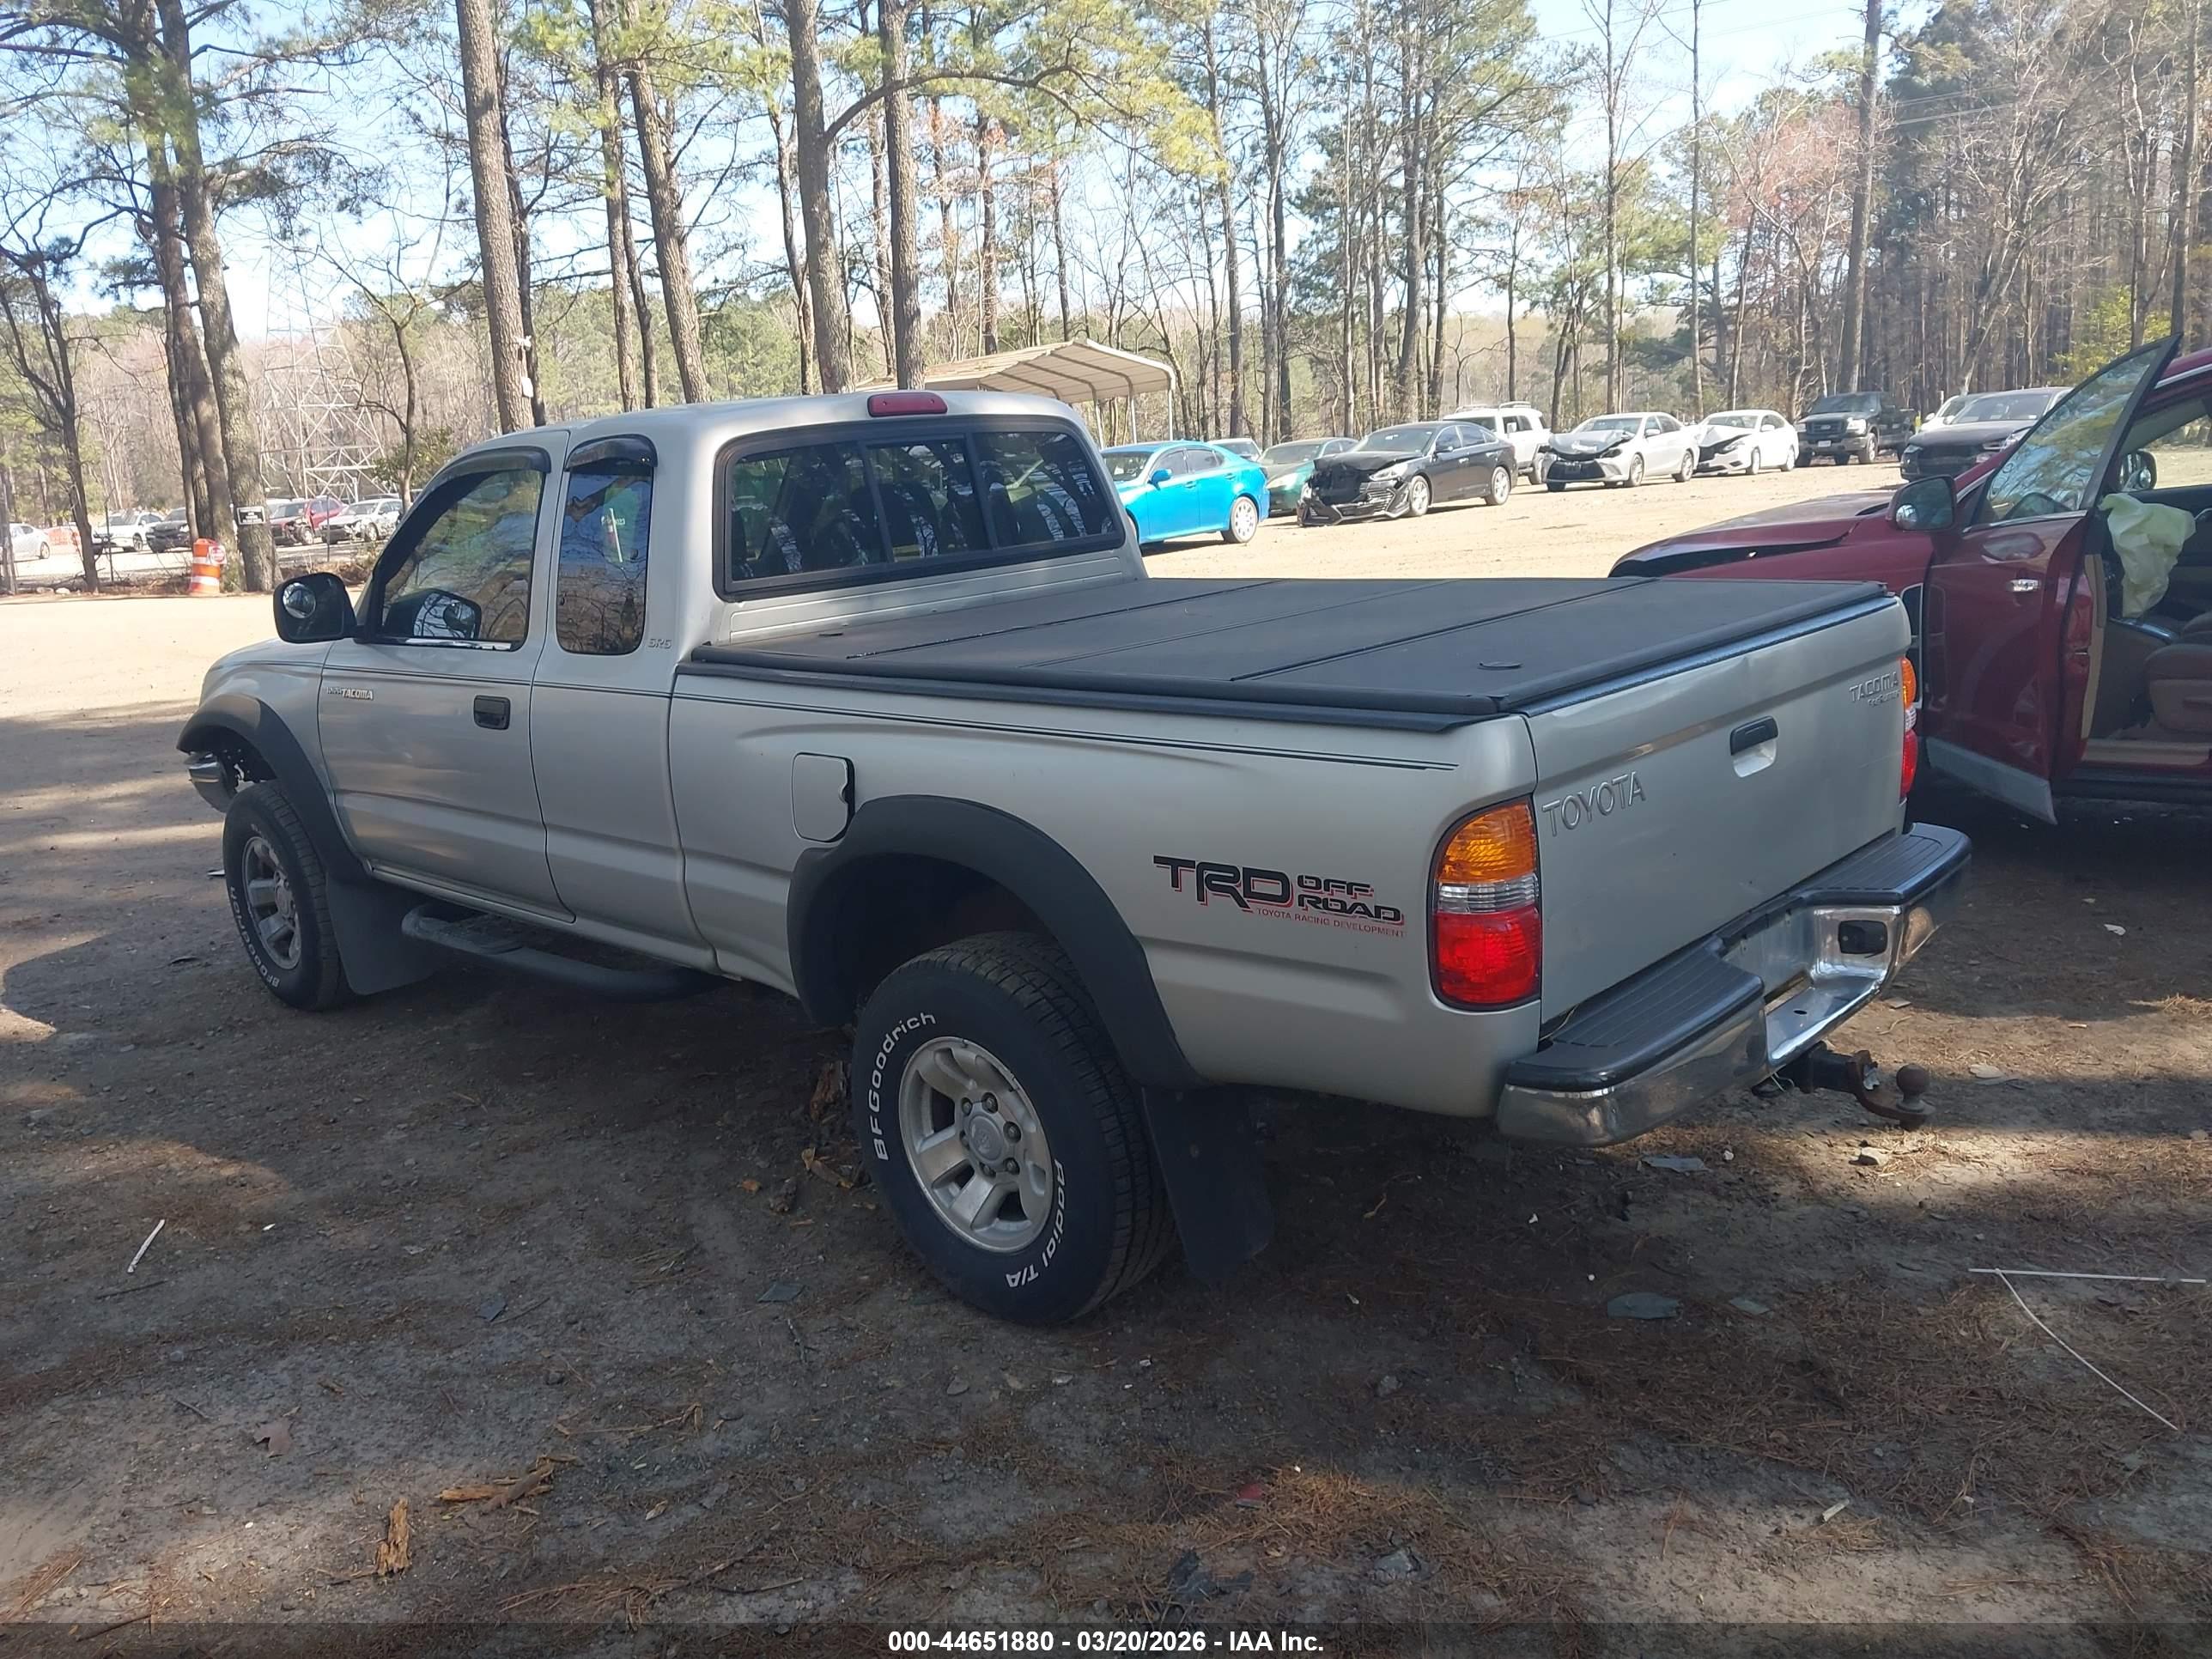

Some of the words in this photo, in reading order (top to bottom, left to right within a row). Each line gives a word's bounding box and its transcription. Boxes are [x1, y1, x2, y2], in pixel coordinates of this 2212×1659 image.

[342, 689, 374, 701] TACOMA
[1849, 672, 1899, 702] TACOMA
[1542, 771, 1647, 837] TOYOTA
[1152, 854, 1295, 915] TRD
[1297, 873, 1374, 899] OFF
[1256, 906, 1292, 921] TOYOTA
[1294, 912, 1331, 927] RACING
[1333, 920, 1407, 939] DEVELOPMENT
[1297, 894, 1405, 926] ROAD
[867, 1012, 937, 1162] BFGoodrich
[1042, 1158, 1066, 1267] Radial
[1005, 1263, 1040, 1289] T/A
